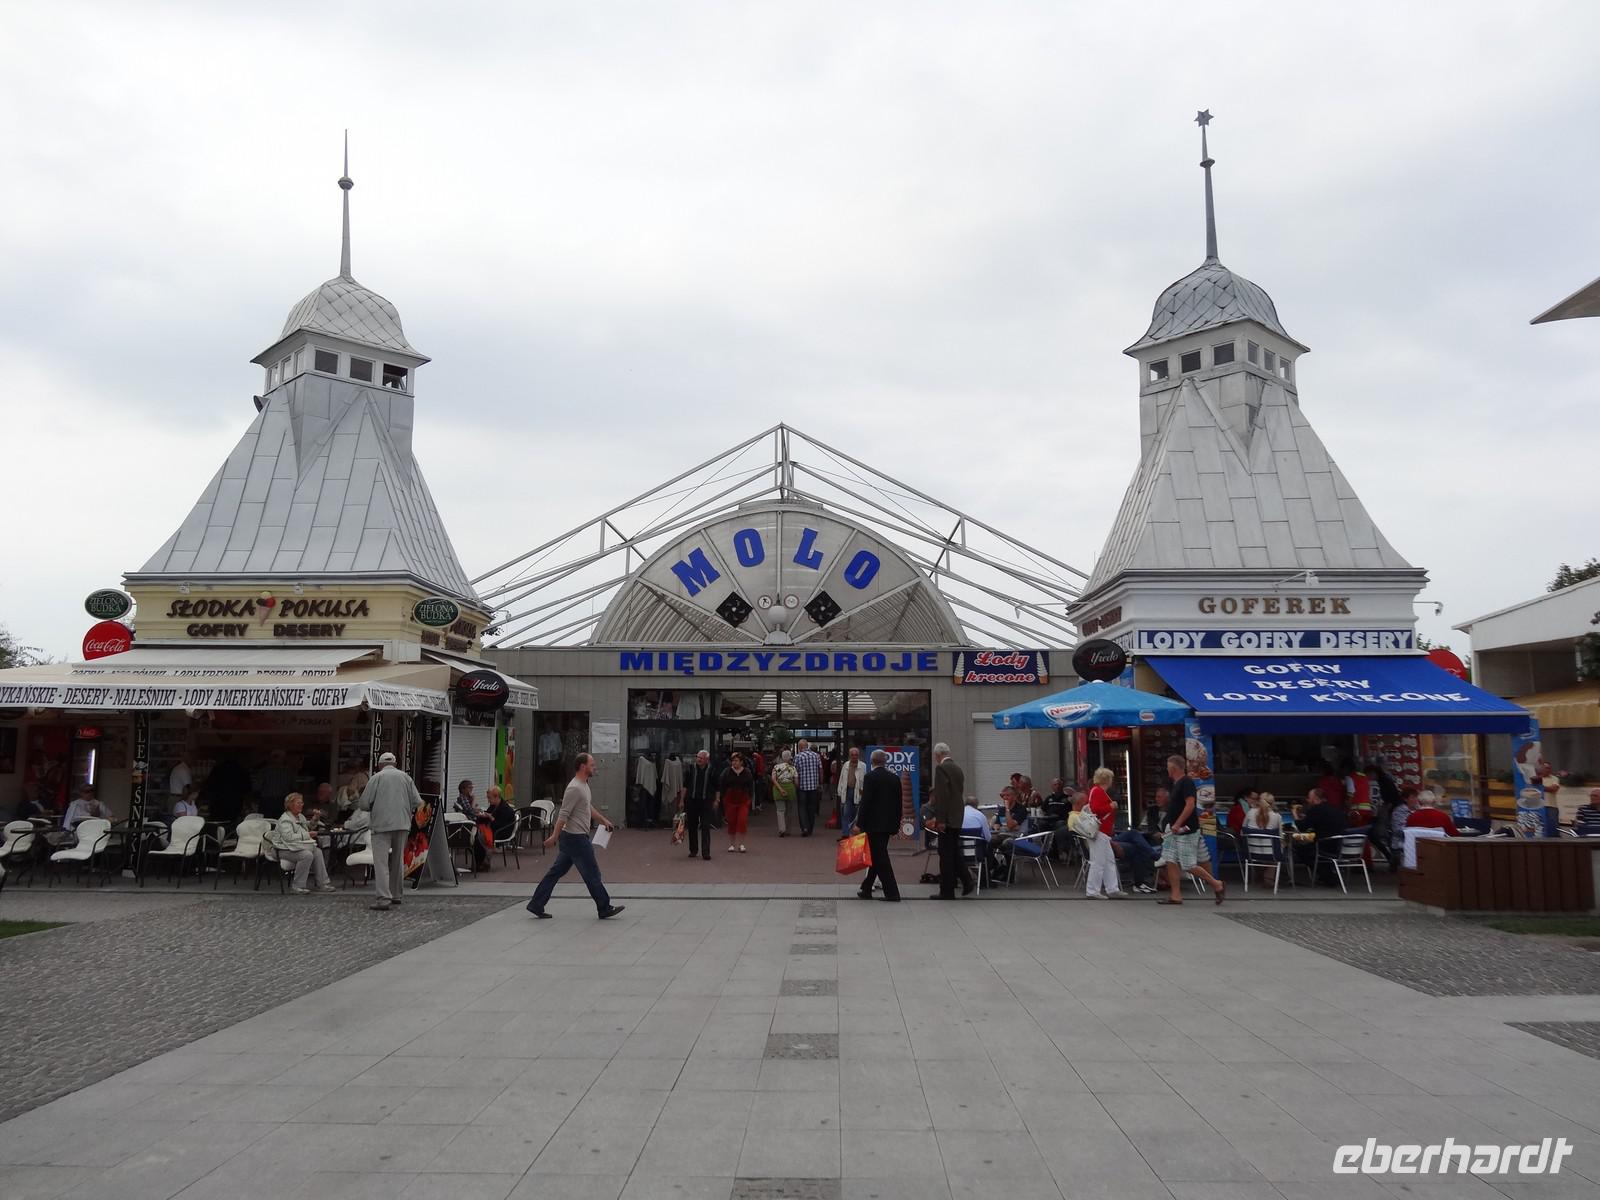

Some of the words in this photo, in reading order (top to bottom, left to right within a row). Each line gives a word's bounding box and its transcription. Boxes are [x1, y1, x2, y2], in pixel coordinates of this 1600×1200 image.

[671, 527, 880, 597] MOLO
[167, 599, 256, 618] SŁODKA
[279, 599, 369, 618] POKUSA
[419, 604, 454, 613] ZIELONA
[1198, 597, 1351, 614] GOFEREK
[420, 611, 452, 620] BUDKA
[187, 623, 249, 637] GOFRY
[273, 623, 346, 637] DESERY
[1141, 631, 1207, 649] LODY
[1221, 631, 1305, 649] GOFRY
[1320, 631, 1412, 649] DESERY
[620, 652, 938, 676] MIĘDZYZDROJE
[974, 651, 1030, 670] Lody
[1243, 664, 1342, 674] GOFRY
[1251, 679, 1371, 689] DESERY
[0, 684, 59, 704] YKAŃSKIE
[63, 687, 110, 705] DESERY
[112, 686, 177, 706] NALEŚNIKI
[182, 688, 214, 706] LODY
[213, 686, 306, 707] AMERYKAŃSKIE
[311, 687, 349, 706] GOFRY
[1203, 692, 1288, 702] LODY
[885, 752, 915, 764] ODY
